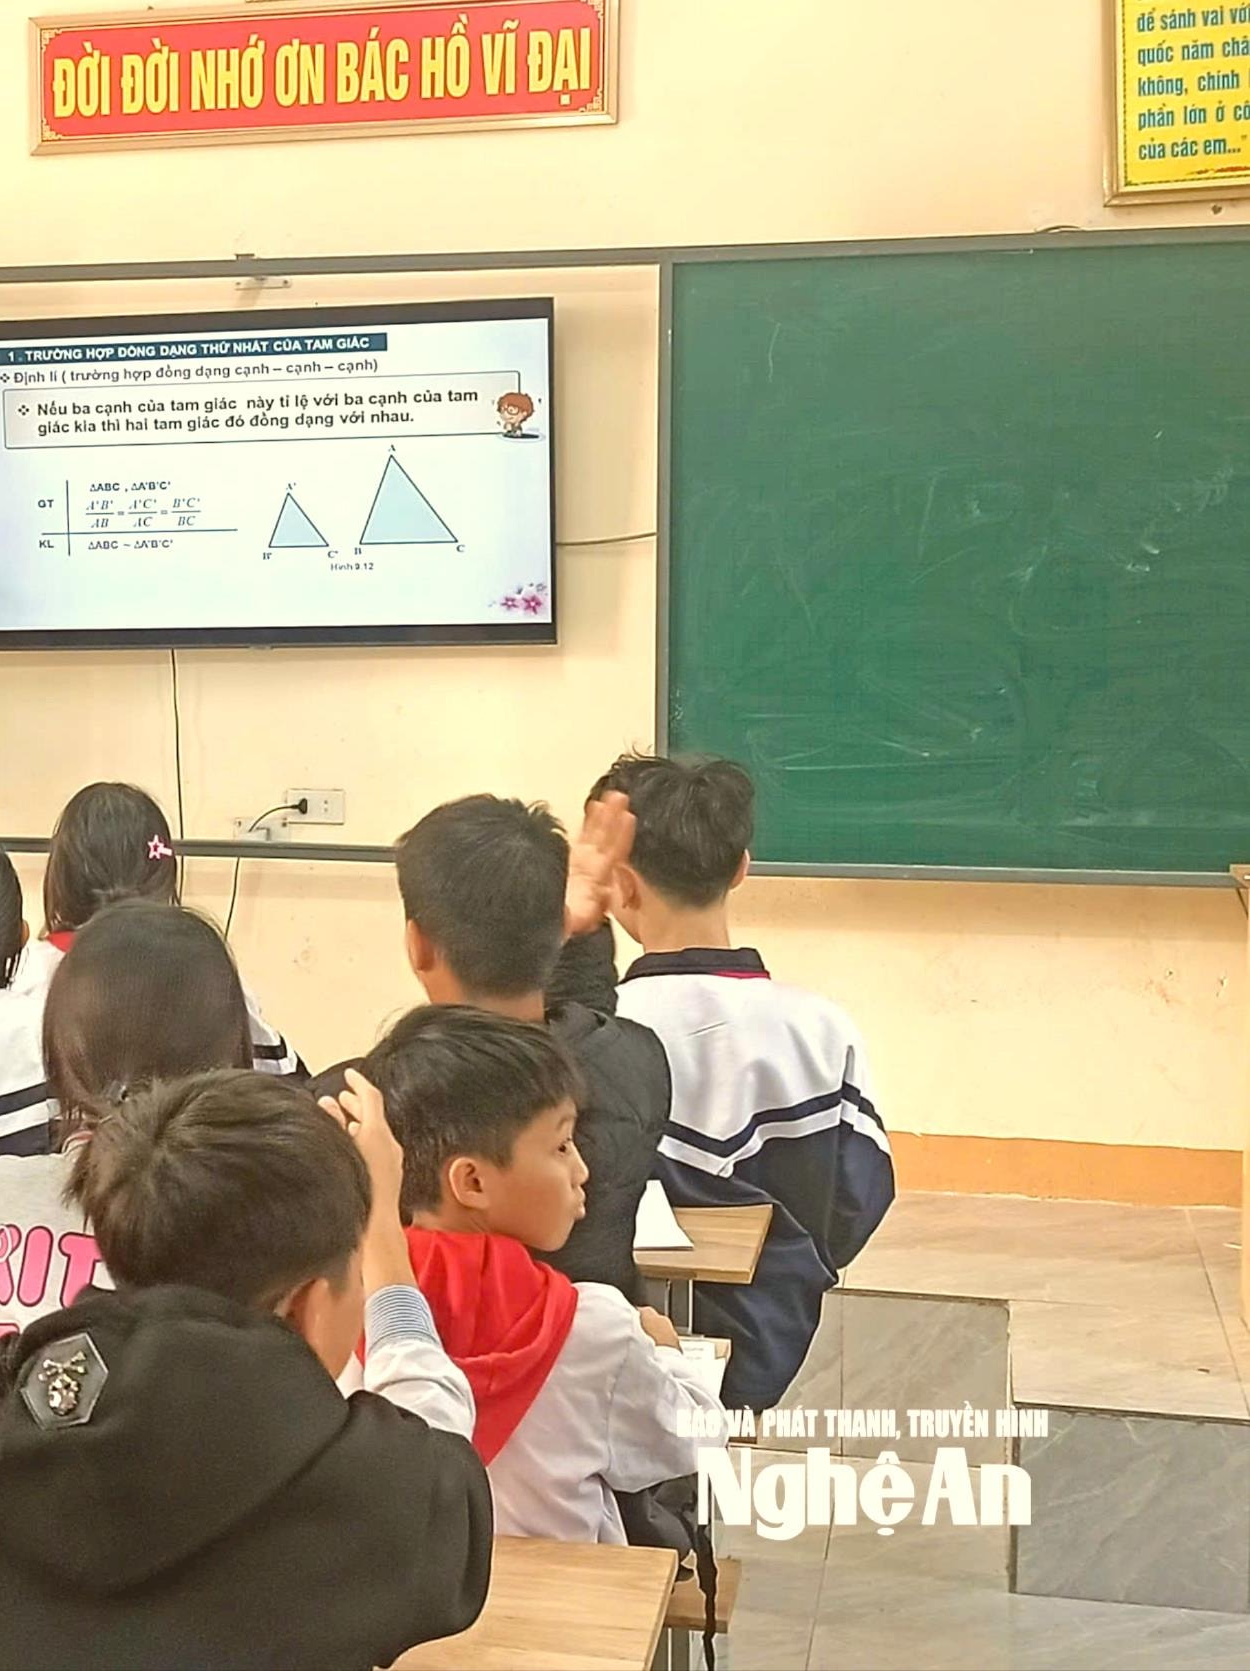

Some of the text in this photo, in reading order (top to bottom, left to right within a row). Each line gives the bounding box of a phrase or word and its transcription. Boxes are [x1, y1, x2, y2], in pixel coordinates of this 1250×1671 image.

[1137, 2, 1250, 33] để sánh vai vớ
[51, 13, 592, 119] ĐỜI ĐỜI NHỚ ƠN BÁC HỒ VĨ ĐẠI
[1138, 39, 1215, 67] quốc năm
[1138, 69, 1240, 97] không, chính
[1138, 102, 1175, 131] phần
[1183, 104, 1207, 126] lớn
[1138, 136, 1198, 161] của các
[7, 352, 16, 362] 1
[86, 346, 115, 361] HỢP
[160, 343, 197, 359] DẠNG
[273, 338, 302, 351] CỦA
[305, 338, 334, 350] TAM
[336, 336, 370, 349] GIÁC
[13, 358, 378, 386] Định lí trường hợp đồng dạng cạnh cạnh cạnh)
[37, 400, 68, 416] Nếu
[72, 401, 91, 415] ba
[95, 401, 132, 417] cạnh
[138, 398, 165, 412] của
[170, 398, 199, 411] tam
[204, 397, 237, 414] giác
[246, 396, 275, 412] này
[295, 394, 308, 410] lệ
[313, 393, 339, 407] với
[344, 392, 364, 406] ba
[368, 391, 407, 408] cạnh
[413, 389, 442, 403] của
[447, 389, 479, 403] tam
[38, 410, 415, 437] giác kia thì hai tam giác đó đồng dạng với nhau.
[38, 539, 55, 549] KL
